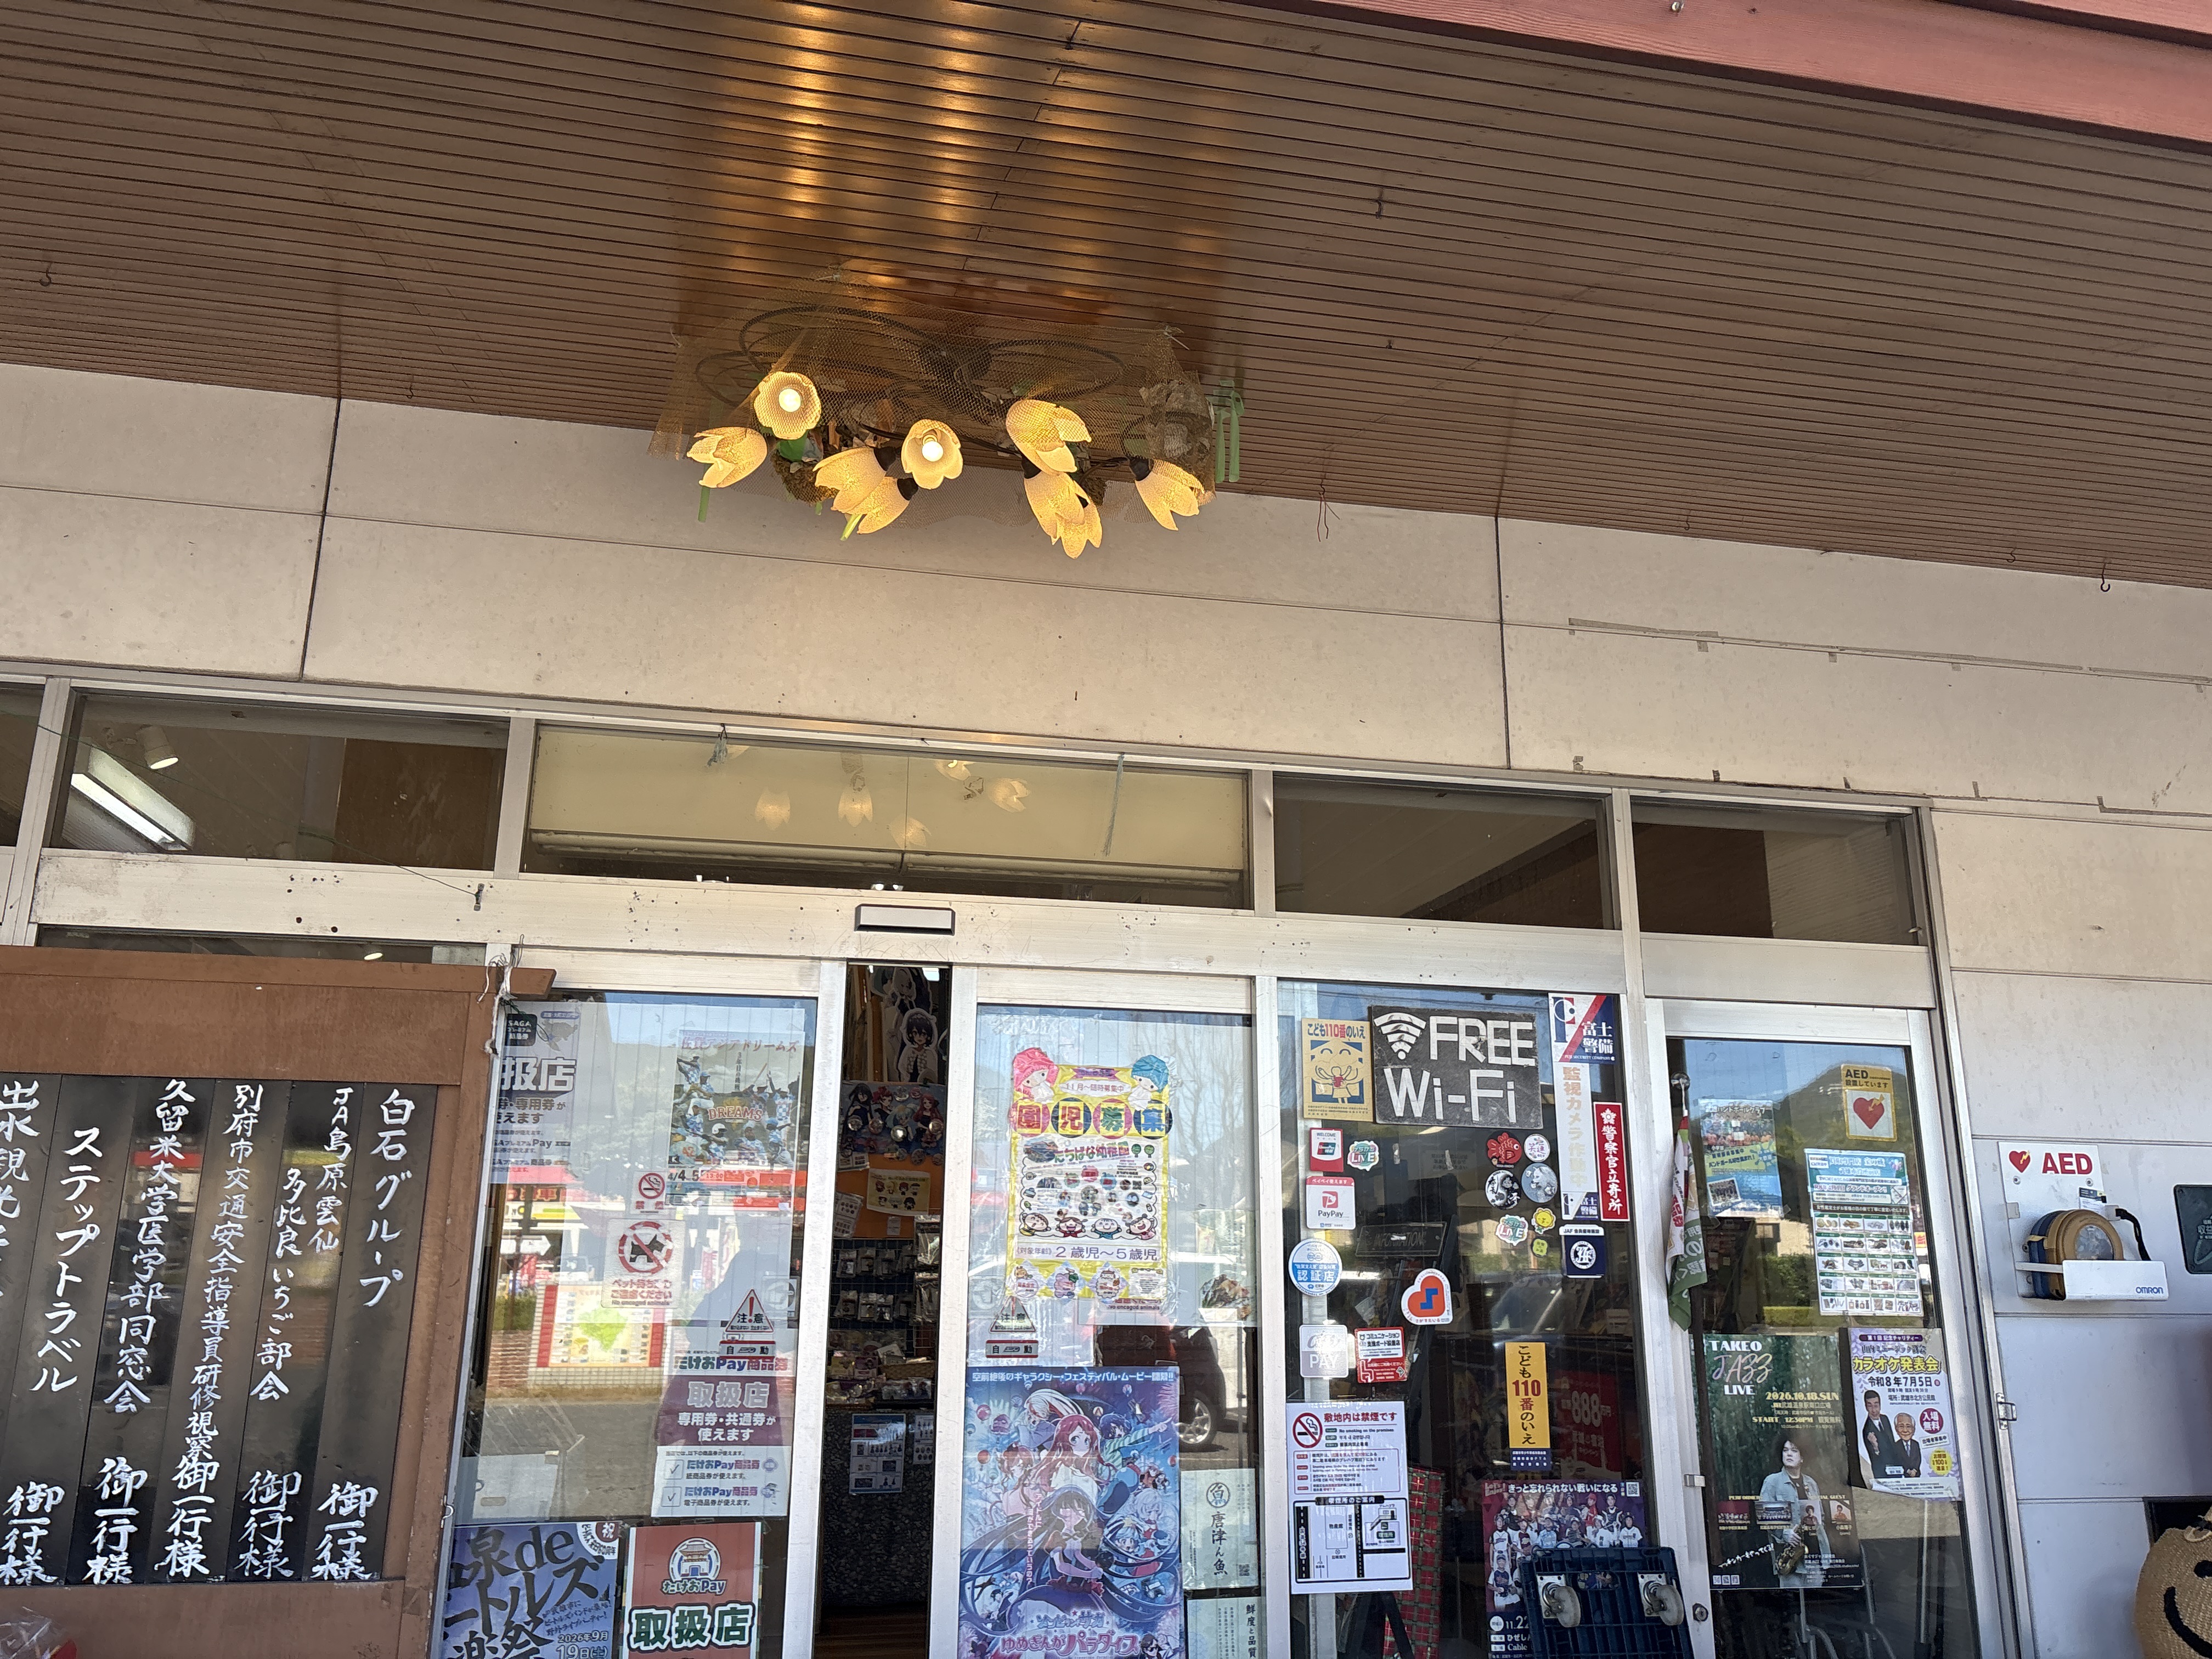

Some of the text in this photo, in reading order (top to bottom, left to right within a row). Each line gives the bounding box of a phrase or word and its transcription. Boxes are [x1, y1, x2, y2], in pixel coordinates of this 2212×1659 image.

[1308, 1023, 1365, 1039] こども110番のいえ
[1582, 1021, 1612, 1037] 富士
[1429, 1015, 1534, 1066] FREE
[1582, 1037, 1613, 1054] 警備
[1845, 1069, 1869, 1079] AED
[1845, 1080, 1888, 1088] 設置しています
[1383, 1066, 1516, 1124] Wi-Fi
[707, 1107, 764, 1121] DREAMS
[1018, 1103, 1165, 1132] 園児募集
[1561, 1066, 1589, 1189] 監視カメラ作動中
[1351, 1152, 1375, 1163] LIVE
[2041, 1152, 2094, 1175] AED
[307, 1087, 355, 1255] JA島原雲仙
[1601, 1125, 1624, 1216] 警察官立寄所
[1318, 1210, 1344, 1218] PayPay
[1500, 1228, 1523, 1238] LIVE
[30, 1126, 103, 1393] ステップトラベル
[1297, 1269, 1335, 1282] 認証店
[2135, 1286, 2164, 1294] OMRON
[737, 1313, 764, 1324] 注意
[1001, 1313, 1026, 1322] 注意
[82, 1079, 196, 1585] 久留米大学医学部同窓会 御一行様
[157, 1083, 262, 1578] 別府市交通安全指導員研修視察 御一行様
[310, 1087, 416, 1581] 白石グループ 御一行様
[727, 1346, 769, 1355] 自動
[992, 1345, 1032, 1354] 自動
[1708, 1340, 1762, 1352] TAKEO
[1310, 1353, 1339, 1369] PAY
[1712, 1352, 1773, 1384] JAZZ
[1852, 1356, 1940, 1373] カラオケ発表会
[238, 1167, 308, 1579] 多比良いちご部会 御一行様
[1867, 1376, 1932, 1387] 令和8年7月5日
[687, 1381, 770, 1408] 取扱店
[1512, 1345, 1541, 1444] こども110番のいえ
[1724, 1384, 1756, 1395] LIVE
[1765, 1391, 1839, 1401] 2026.10.18.SUN
[677, 1412, 776, 1426] 専用券・共通券が
[1324, 1412, 1397, 1422] 敷地内は禁煙です
[1922, 1412, 1939, 1421] 入場
[1923, 1421, 1940, 1431] 無料
[698, 1427, 754, 1442] 使えます
[686, 1459, 760, 1470] たけおPay商品券
[684, 1486, 758, 1497] たけおPay商品券
[1508, 1483, 1618, 1493] きっと忘れられない戦いになる
[1211, 1511, 1228, 1576] 唐津ん魚
[663, 1579, 726, 1595] たけおPay
[633, 1607, 751, 1646] 取扱店
[1246, 1604, 1256, 1658] 鮮度と品質
[558, 1630, 608, 1643] 2026年9月
[1001, 1629, 1139, 1656] ゆめぎんがパラダイス
